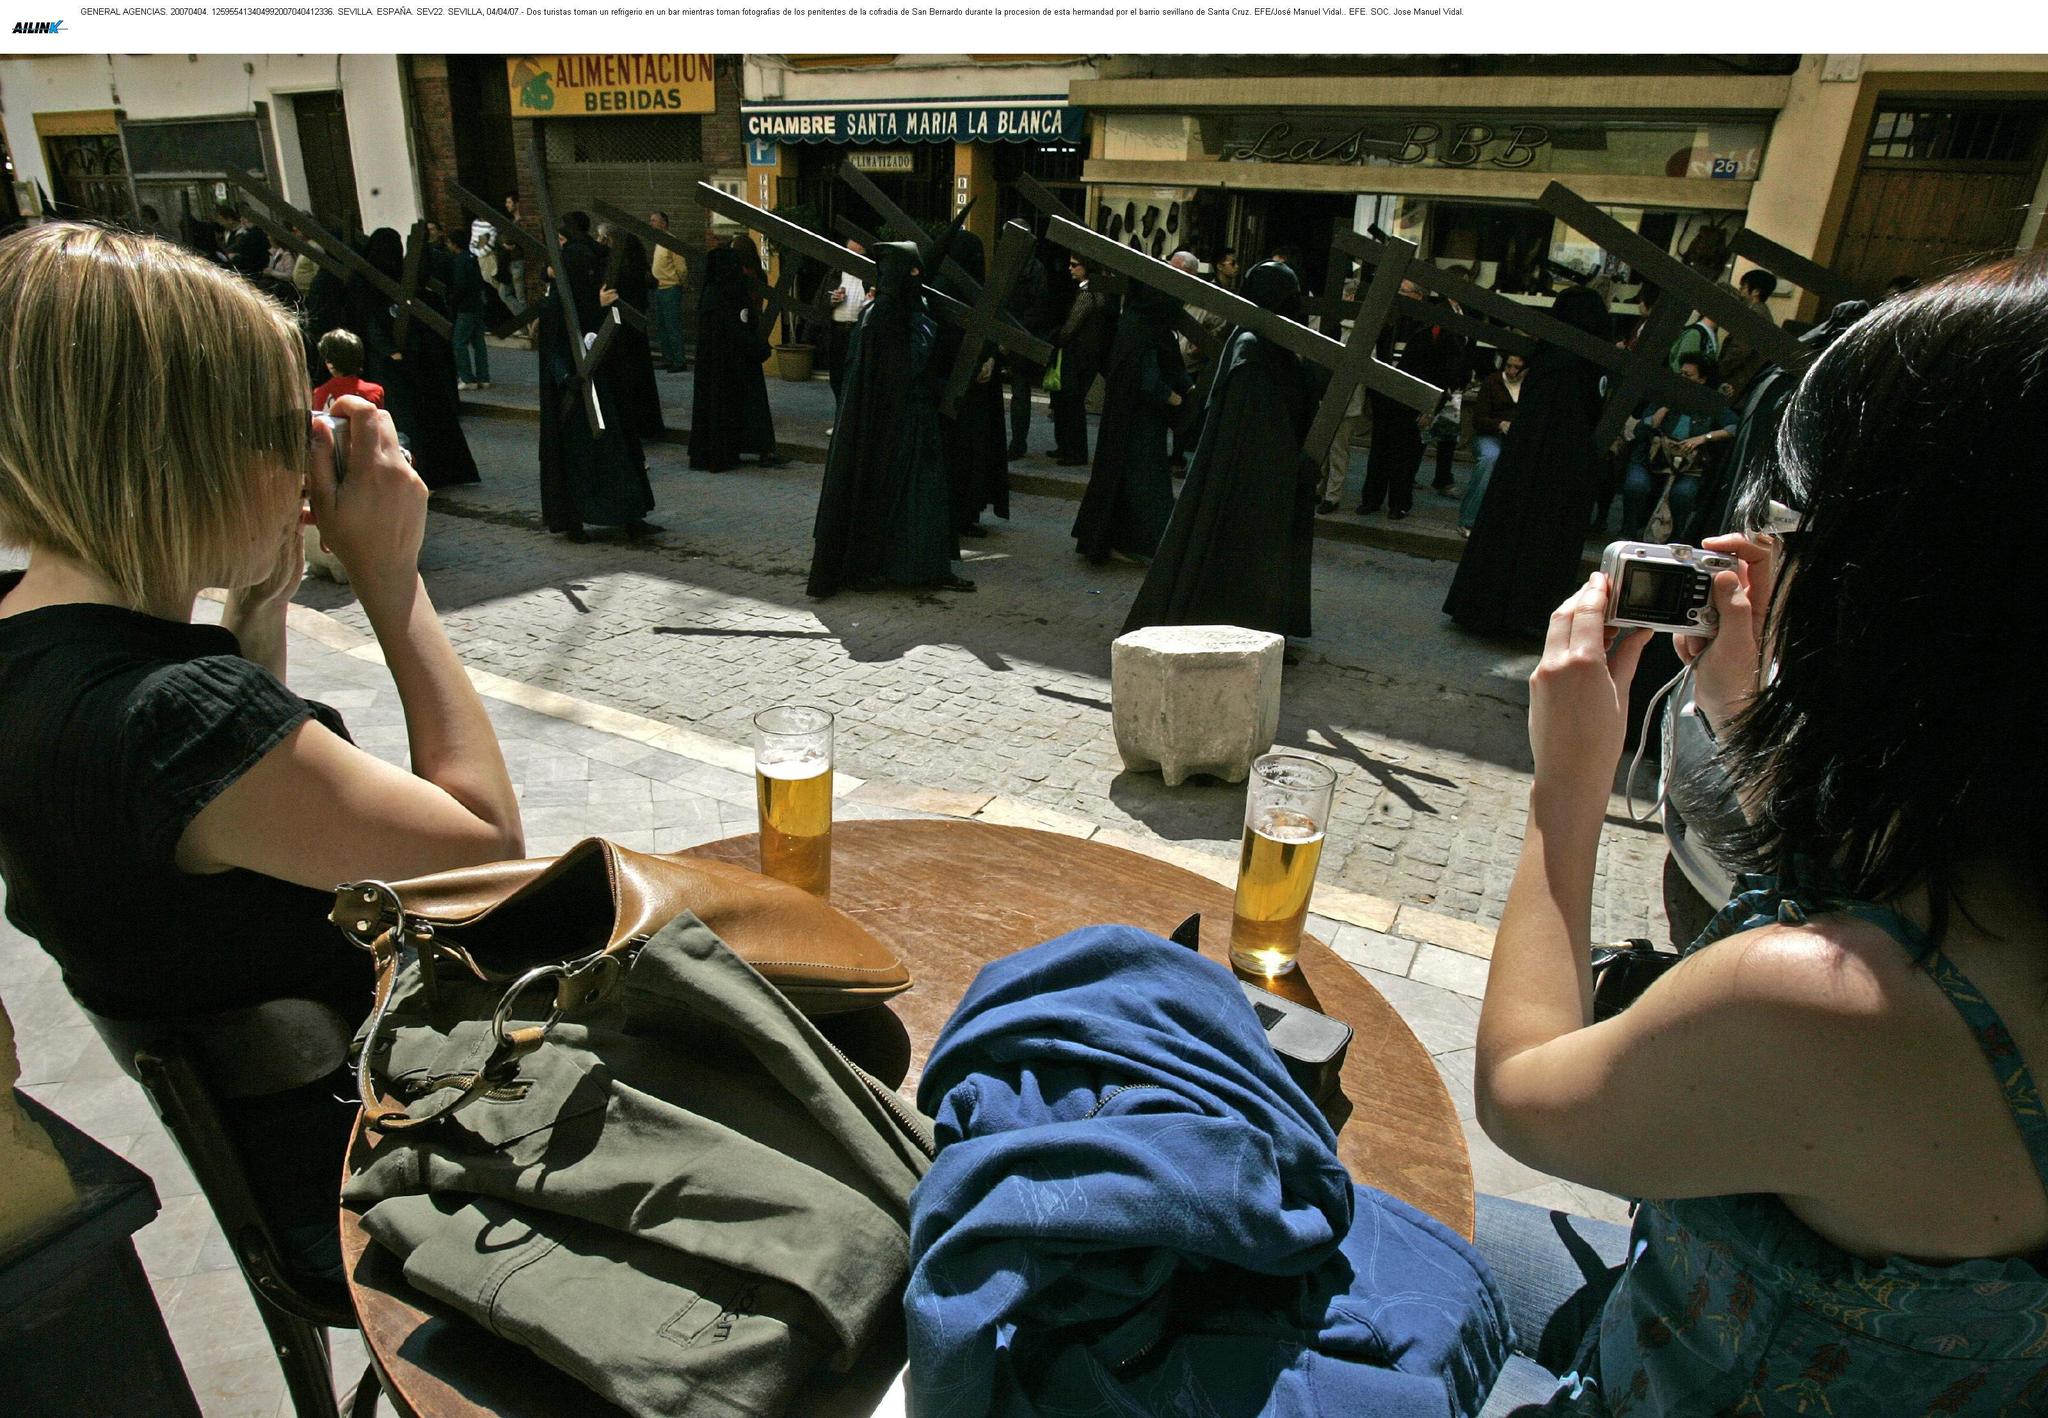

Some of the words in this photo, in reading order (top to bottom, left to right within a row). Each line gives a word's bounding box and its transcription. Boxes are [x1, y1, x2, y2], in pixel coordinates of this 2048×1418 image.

[585, 88, 682, 111] BEBIDAS
[749, 116, 836, 135] CHAMBRE
[847, 112, 897, 135] SANTA
[906, 111, 957, 135] MARIA
[968, 111, 988, 134] LA
[998, 109, 1062, 134] BLANCA
[1714, 160, 1735, 174] 26
